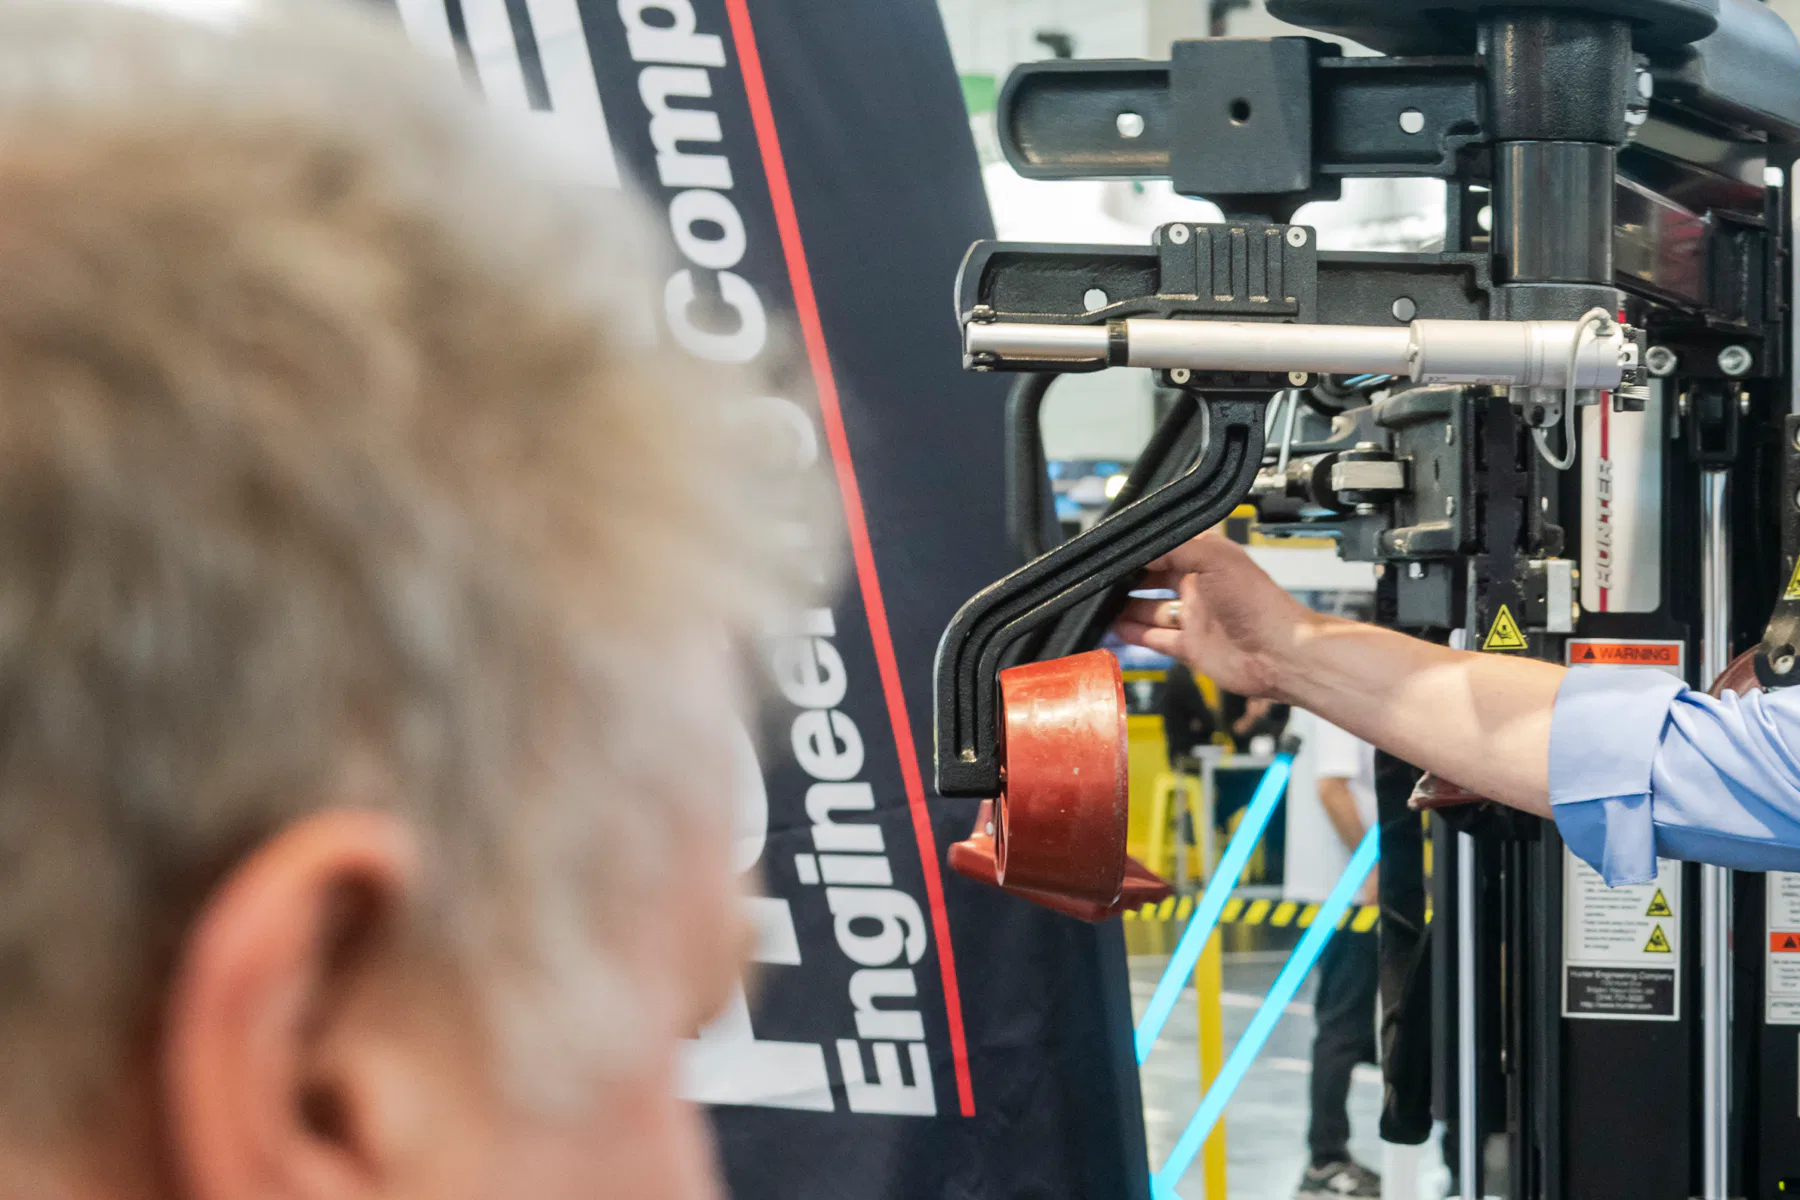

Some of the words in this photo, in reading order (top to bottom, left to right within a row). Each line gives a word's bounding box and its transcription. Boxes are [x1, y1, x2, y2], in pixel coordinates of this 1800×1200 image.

[1595, 456, 1614, 591] HUNTER
[1599, 647, 1671, 661] WARNING
[745, 397, 938, 1117] Engineer
